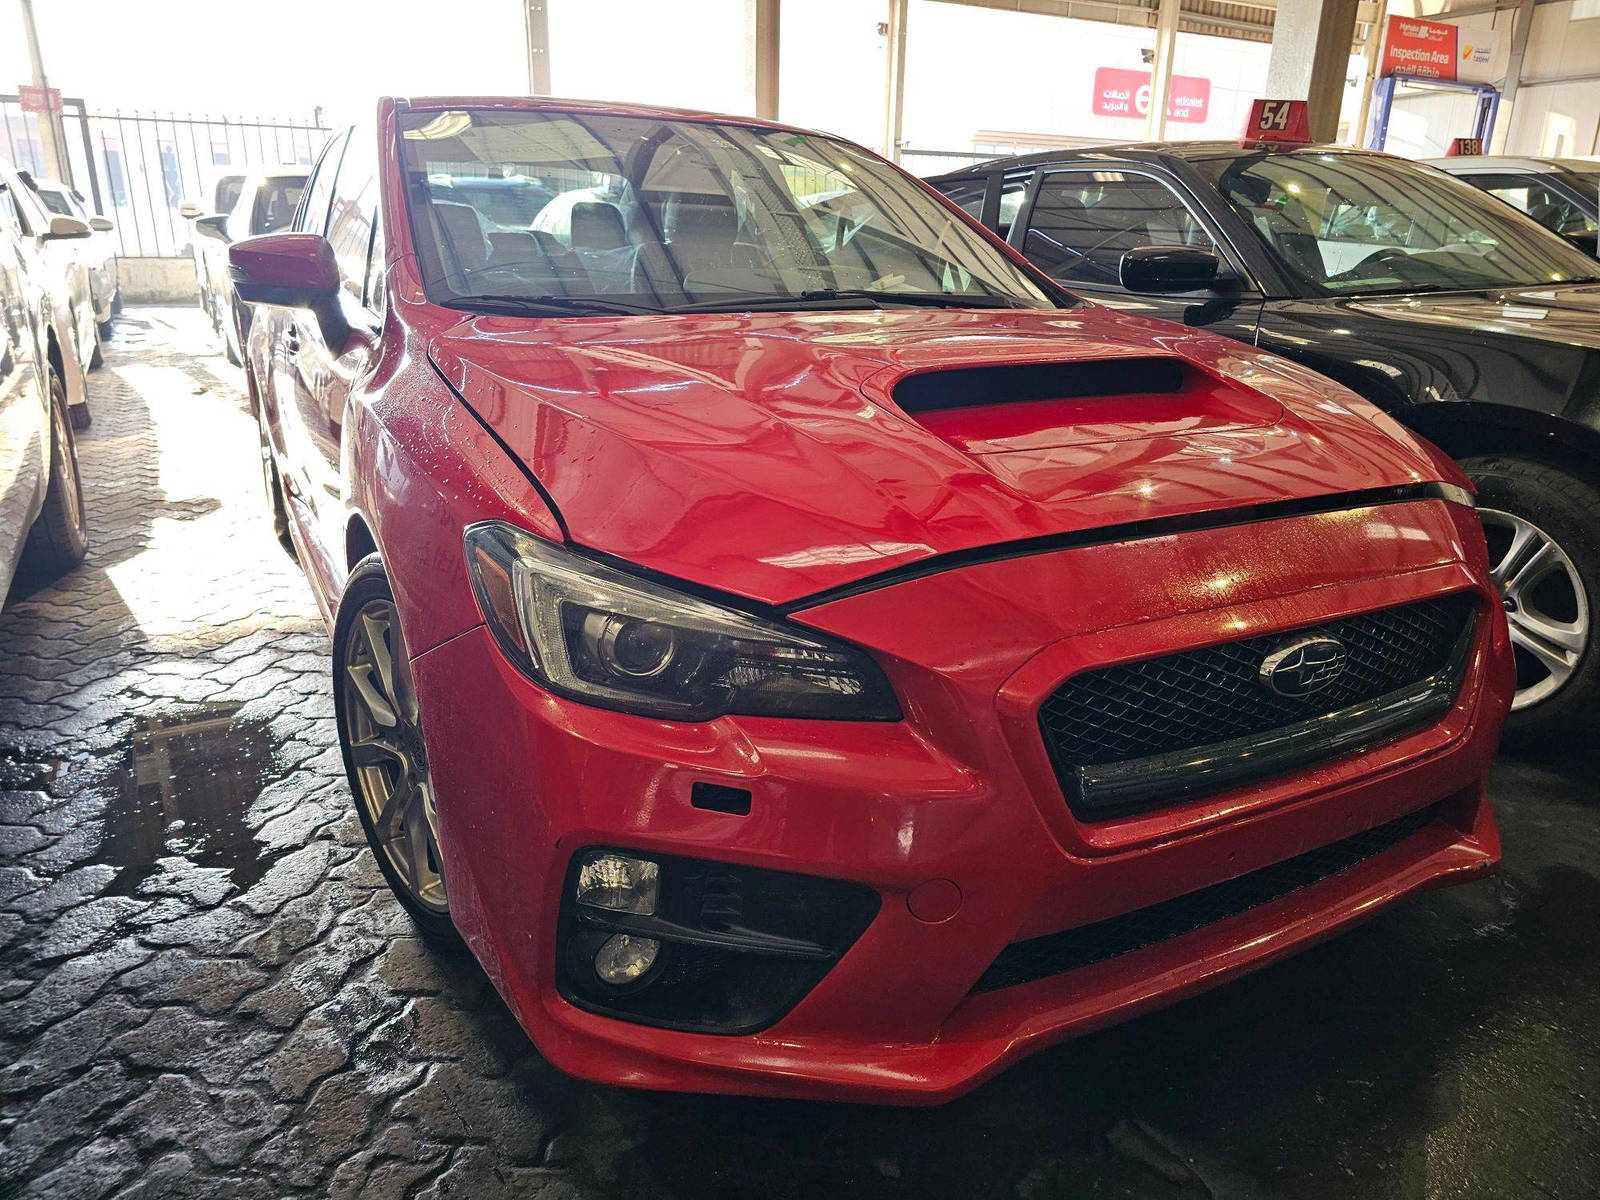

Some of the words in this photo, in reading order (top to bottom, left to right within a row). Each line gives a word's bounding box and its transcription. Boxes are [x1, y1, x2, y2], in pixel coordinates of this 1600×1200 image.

[1390, 45, 1431, 61] Inspection
[1430, 50, 1449, 64] Area
[1174, 108, 1189, 117] and
[1260, 102, 1290, 130] 54
[1460, 139, 1479, 155] 138
